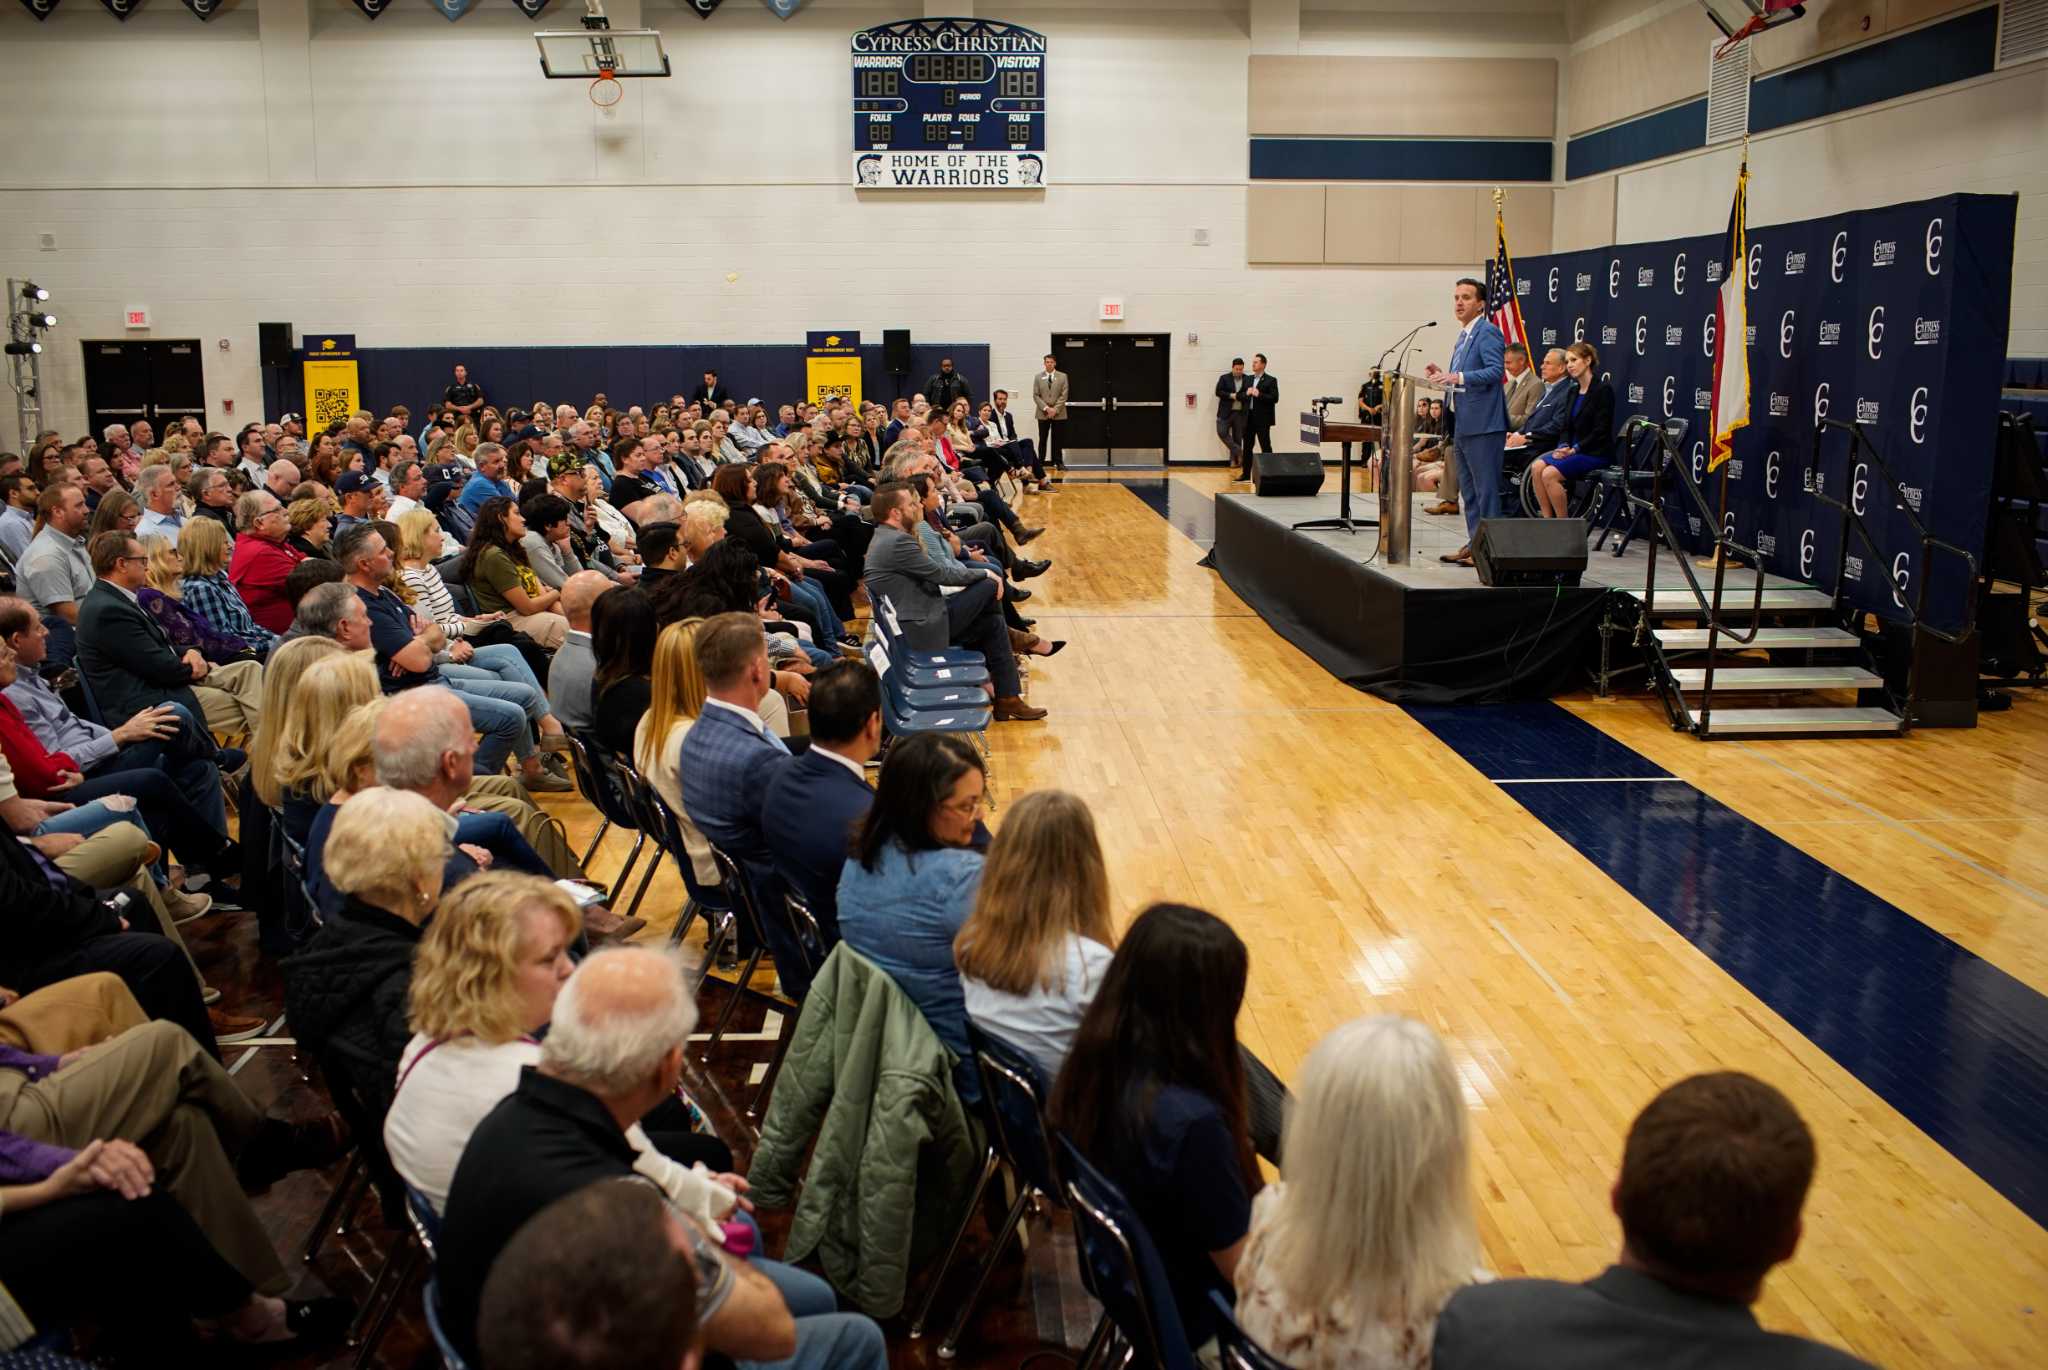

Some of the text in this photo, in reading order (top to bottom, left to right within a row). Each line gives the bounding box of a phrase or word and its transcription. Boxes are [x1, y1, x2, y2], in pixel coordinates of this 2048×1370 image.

[852, 32, 1045, 52] CYPRESS CHRISTIAN
[854, 56, 903, 68] WARRIORS
[997, 56, 1040, 68] VISITOR
[870, 114, 892, 122] FOULS
[923, 114, 980, 122] PLAYER FOULS
[1009, 114, 1031, 122] FOULS
[892, 155, 1008, 167] HOME OF THE
[892, 169, 1009, 185] WARRIORS
